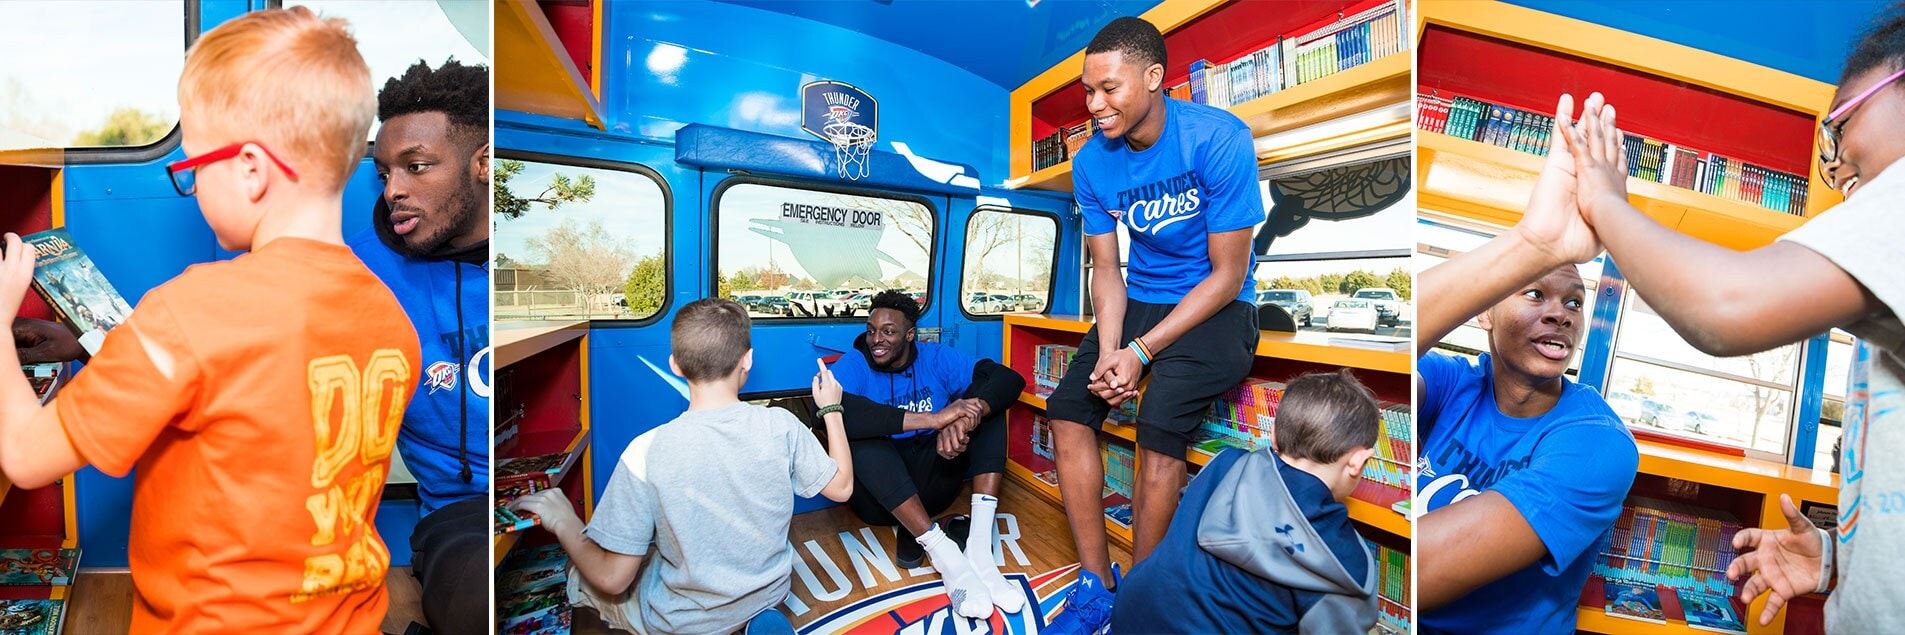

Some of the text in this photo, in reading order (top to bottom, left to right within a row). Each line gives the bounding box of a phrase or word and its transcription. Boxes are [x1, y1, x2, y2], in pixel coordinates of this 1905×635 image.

[822, 91, 860, 111] THUNDER
[783, 202, 881, 226] EMERGENCY DOOR
[1128, 188, 1200, 235] Cares
[34, 235, 73, 259] ARNIA
[308, 348, 411, 488] DO
